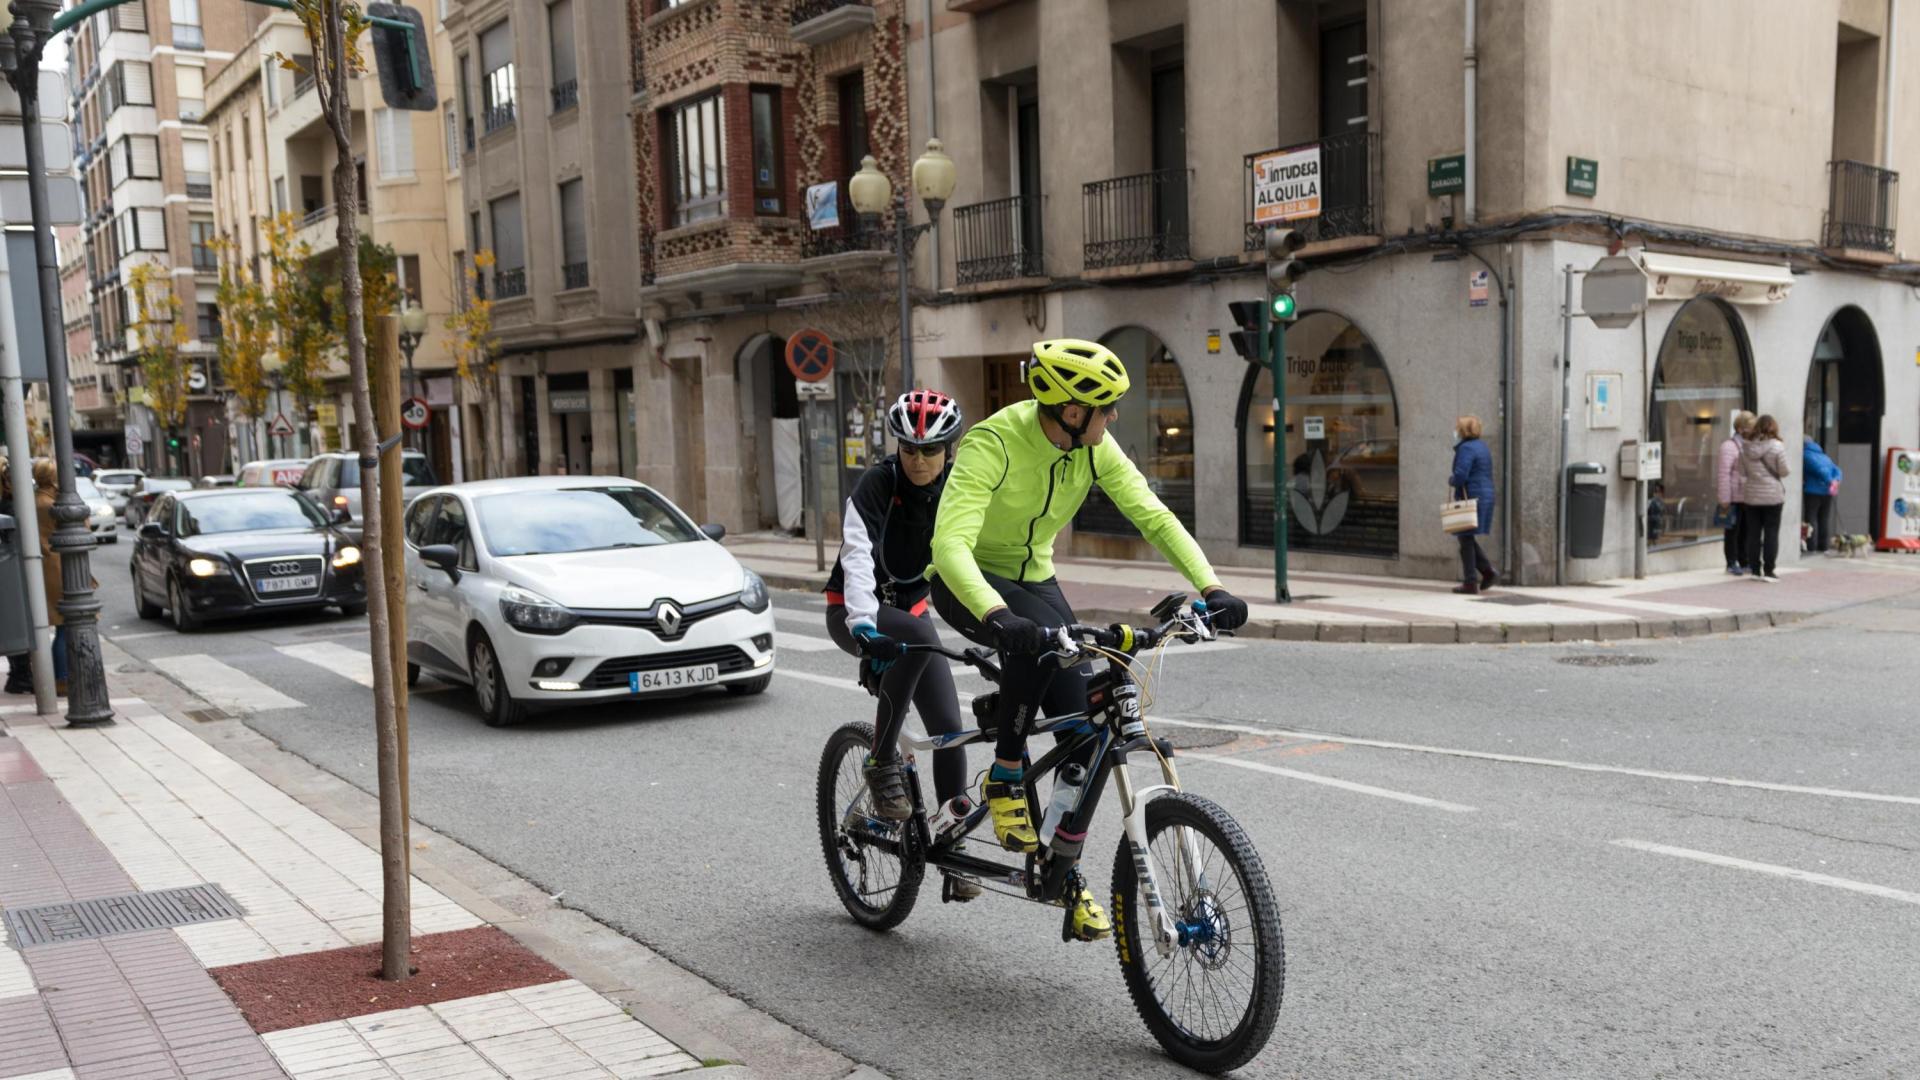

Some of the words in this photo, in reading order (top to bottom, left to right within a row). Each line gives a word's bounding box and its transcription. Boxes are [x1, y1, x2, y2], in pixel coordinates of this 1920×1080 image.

[1258, 181, 1317, 205] ALQUILA
[1431, 176, 1462, 189] ZARAGOZA
[1286, 355, 1316, 377] Trigo
[407, 407, 424, 418] 30
[642, 671, 682, 688] 6413
[686, 667, 715, 683] KJD
[1115, 892, 1131, 963] MAXXIS
